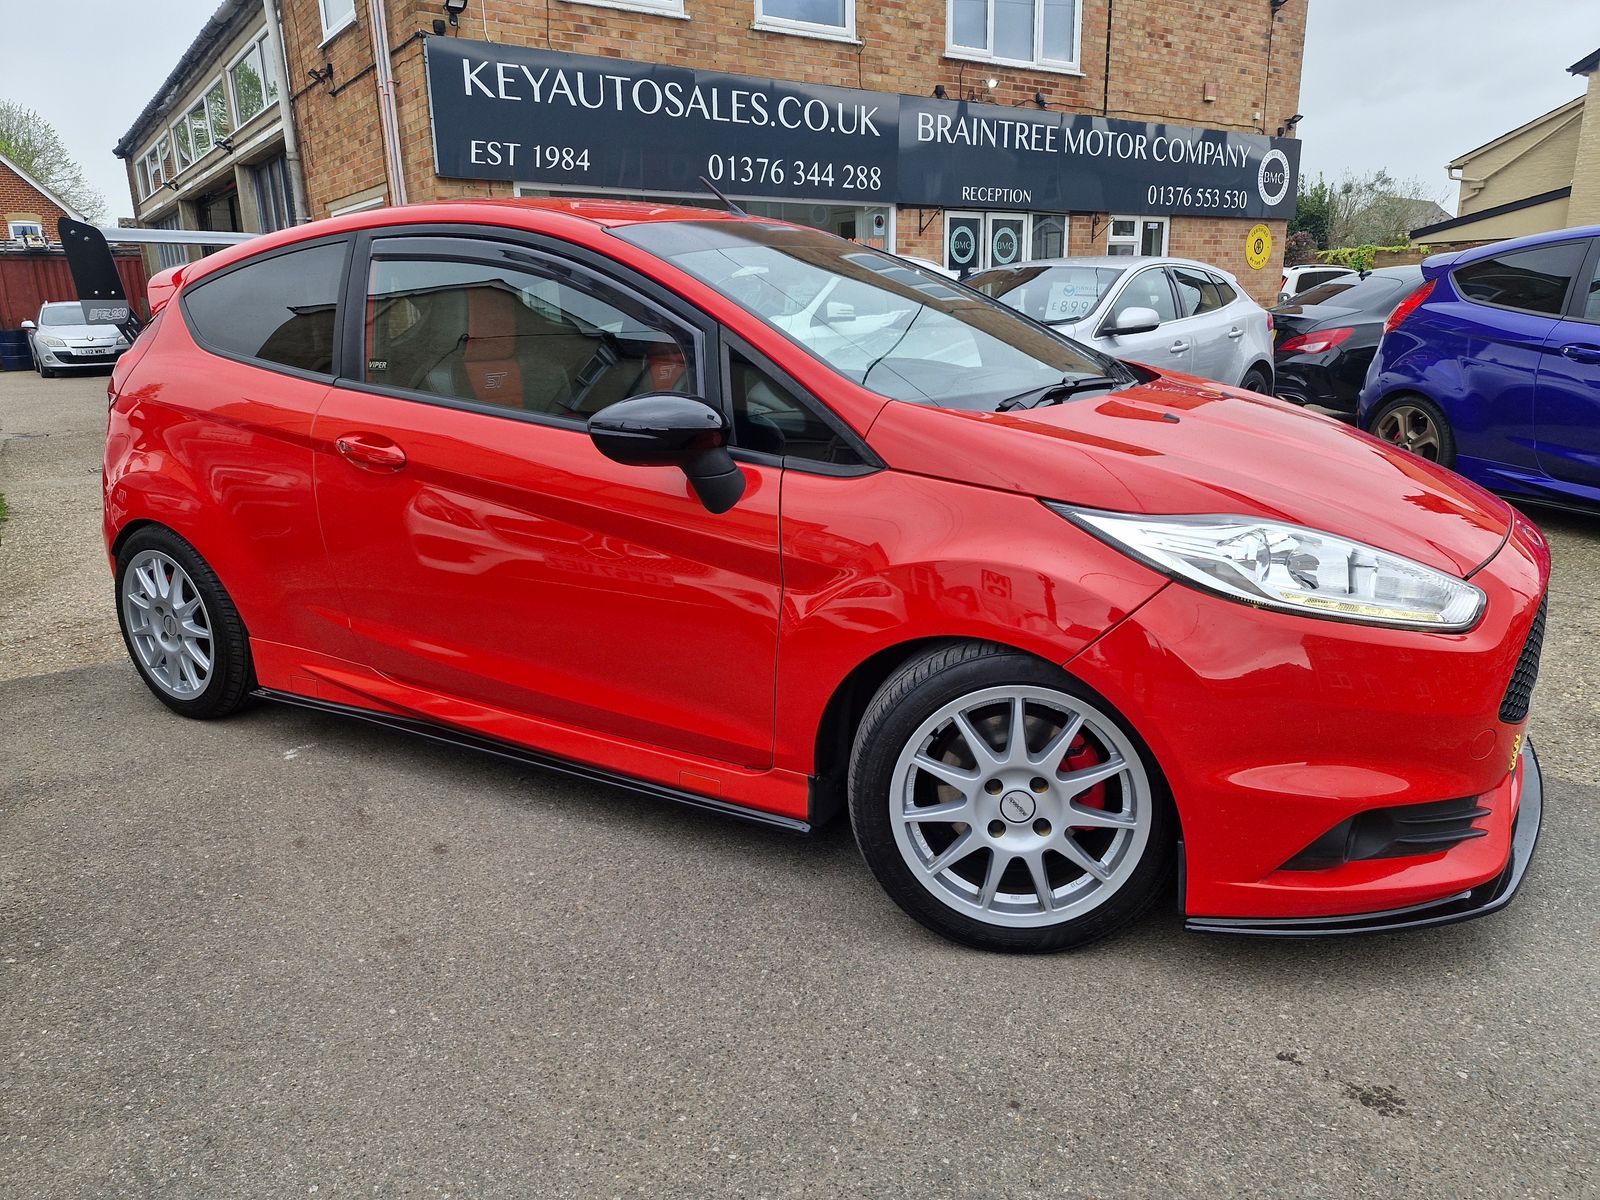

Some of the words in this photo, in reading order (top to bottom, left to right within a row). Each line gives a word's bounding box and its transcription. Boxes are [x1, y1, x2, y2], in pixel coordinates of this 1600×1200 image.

[462, 58, 881, 137] KEYAUTOSALES.CO.UK
[917, 112, 1059, 153] BRAINTREE
[1064, 127, 1147, 160] MOTOR
[1152, 136, 1252, 168] COMPANY
[470, 139, 521, 166] EST
[533, 144, 591, 171] 1984
[708, 154, 785, 185] 01376
[793, 160, 835, 187] 344
[842, 164, 882, 191] 288
[1263, 171, 1284, 185] BMC
[962, 186, 1032, 203] RECEPTION
[1147, 184, 1192, 207] 01376
[1195, 188, 1220, 208] 553
[1223, 190, 1248, 209] 530
[954, 240, 971, 250] BMC
[997, 241, 1014, 251] BMC
[368, 361, 388, 369] VIPER
